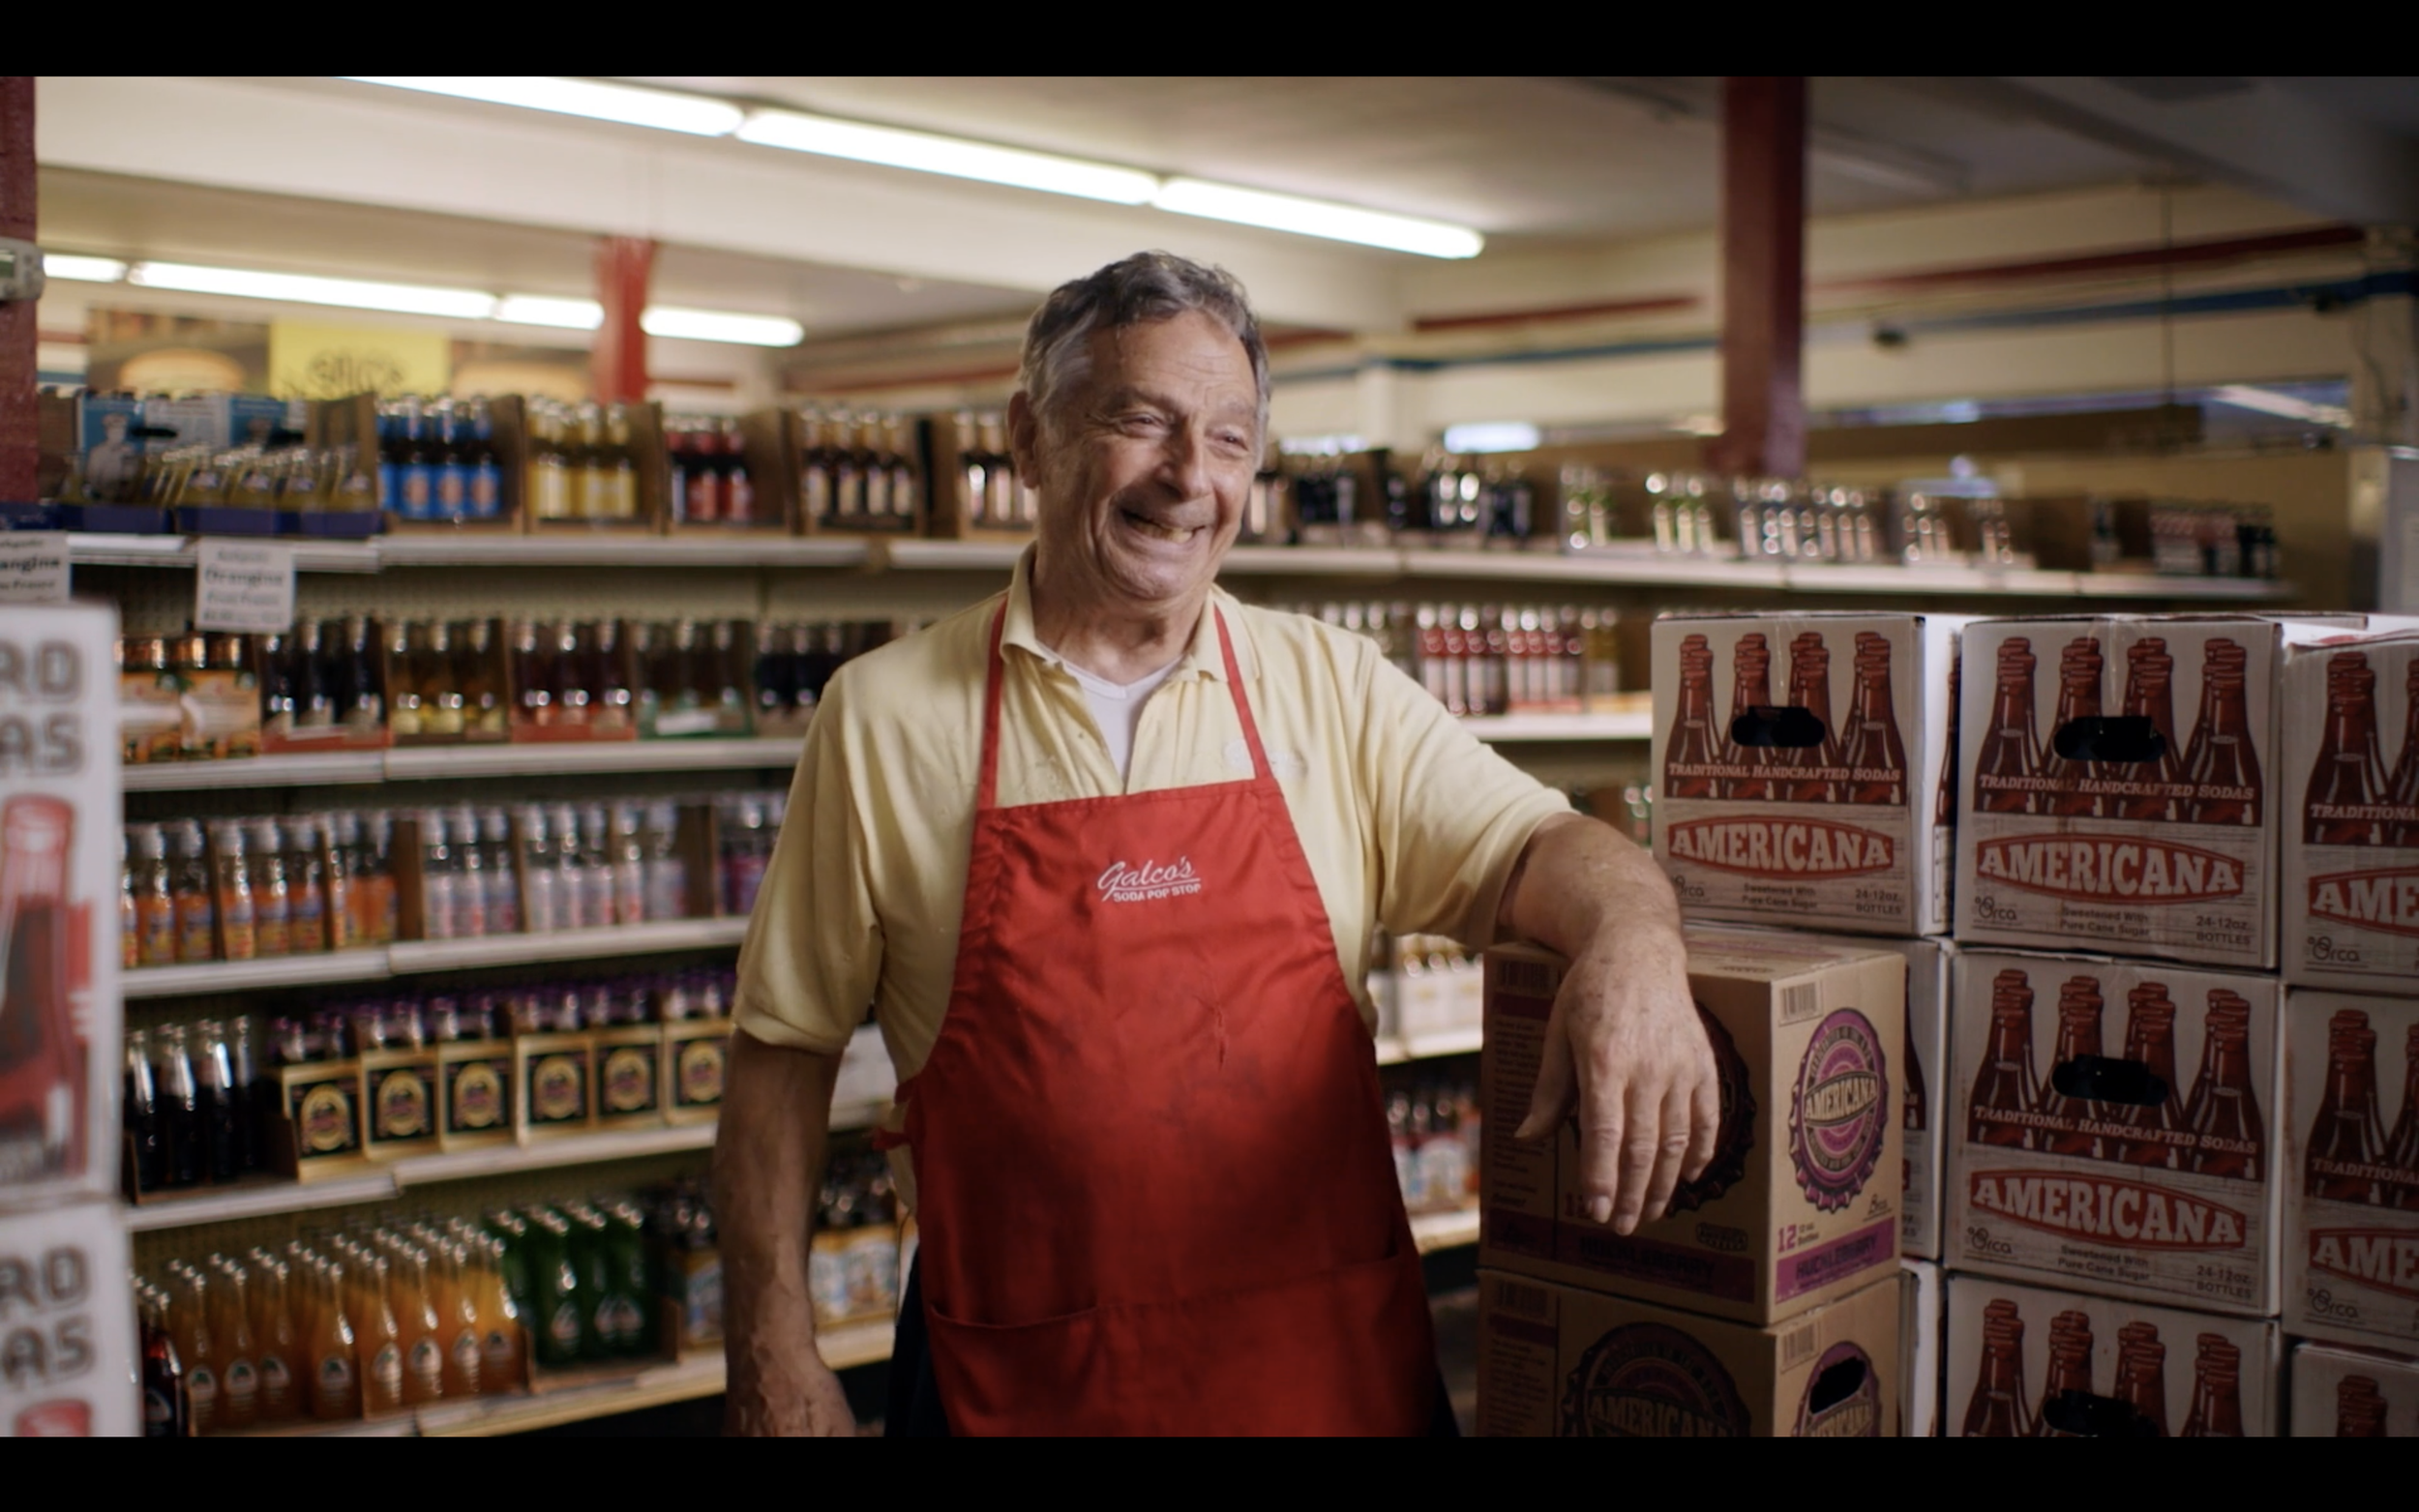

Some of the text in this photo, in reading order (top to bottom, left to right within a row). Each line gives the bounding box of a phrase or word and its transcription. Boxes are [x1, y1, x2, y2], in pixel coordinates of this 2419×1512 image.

[1669, 762, 1901, 783] TRADITIONAL HANDCRAFTED SODAS
[2079, 778, 2194, 797] HANDCRAFTED
[2196, 784, 2255, 801] SODAS
[1670, 822, 1890, 872] AMERICANA
[1097, 855, 1196, 902] Galco's
[1979, 841, 2240, 896] AMERICANA
[1113, 883, 1202, 903] SODA POP STOP
[1856, 903, 1901, 915] BOTTLES
[2123, 911, 2149, 924] With
[2060, 919, 2150, 937] Pure Cane Sugar
[2195, 933, 2252, 945] BOTTLES
[1805, 1076, 1878, 1121] AMERICANA
[1974, 1106, 2257, 1155] TRADITIONAL HANDCRAFTED SODAS
[1972, 1177, 2242, 1243] AMERICANA
[1777, 1224, 1797, 1253] 12
[2057, 1257, 2150, 1282] Pure Cane Sugar
[2123, 1255, 2149, 1267] With
[2196, 1281, 2253, 1299] BOTTLES
